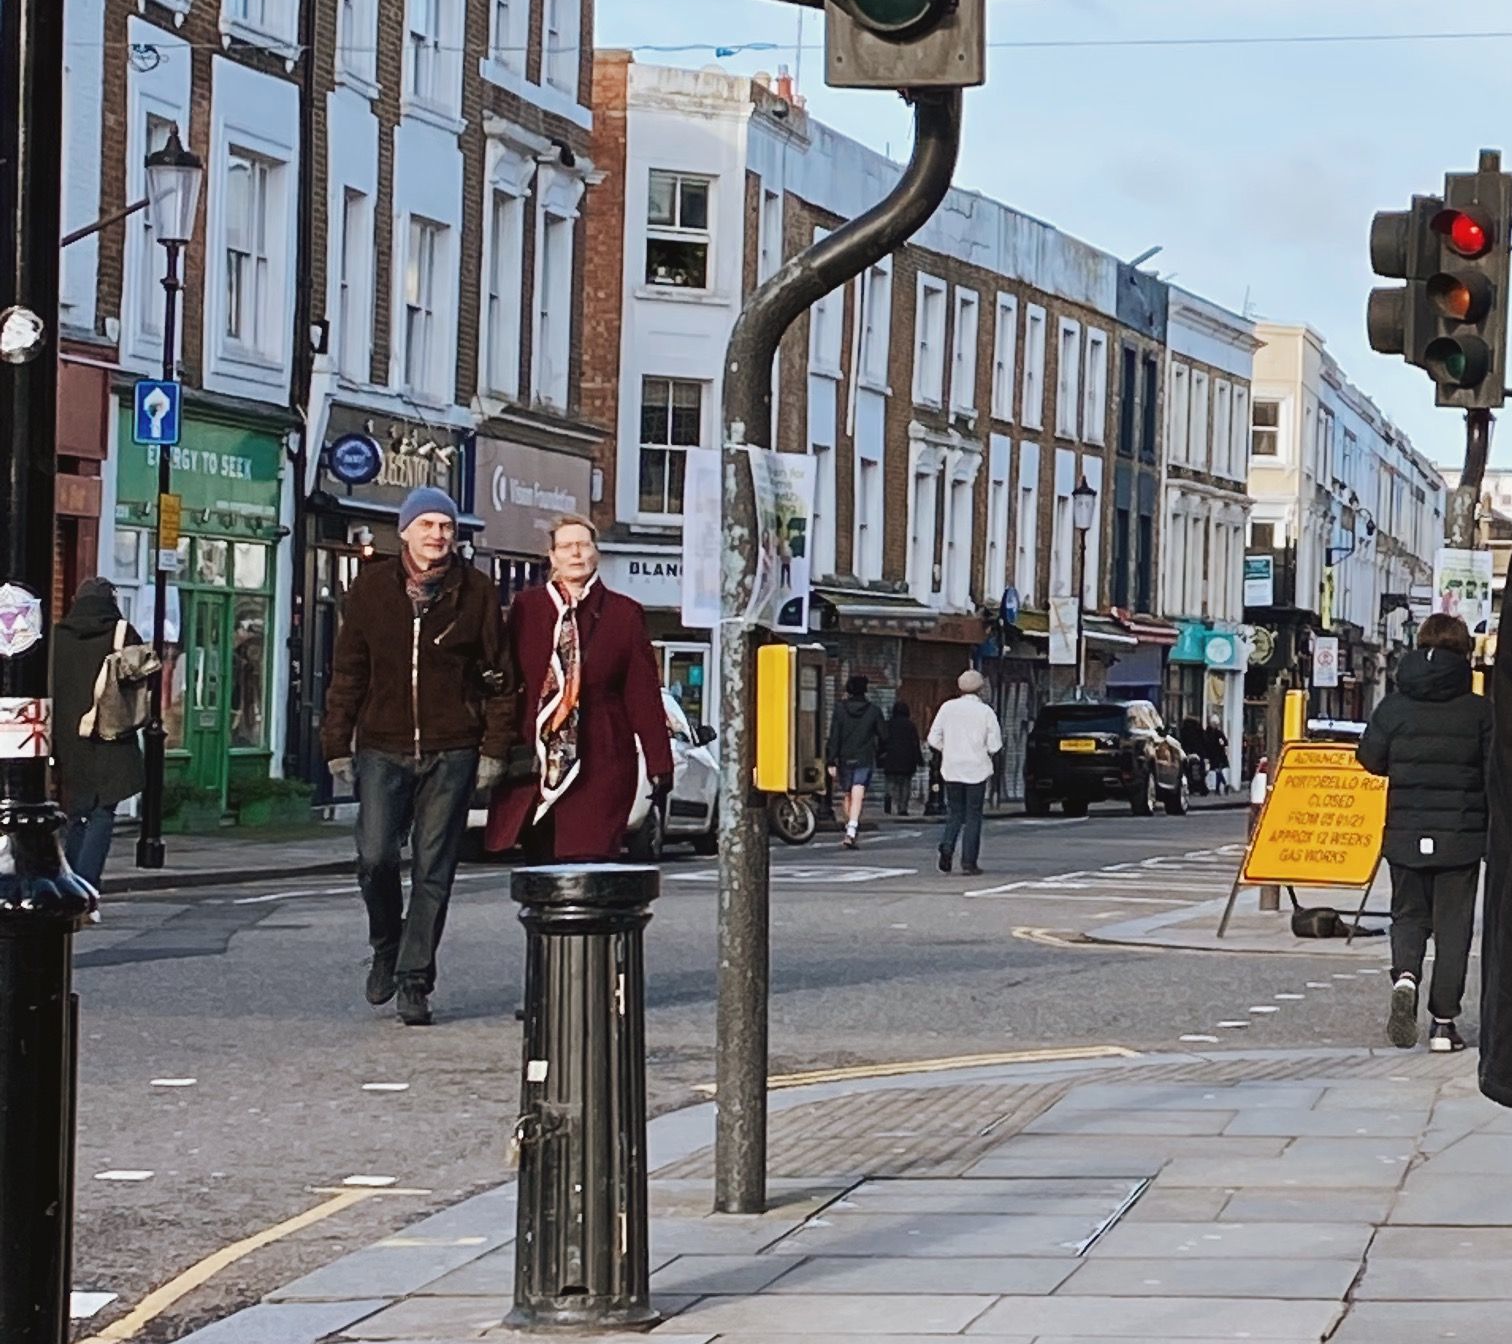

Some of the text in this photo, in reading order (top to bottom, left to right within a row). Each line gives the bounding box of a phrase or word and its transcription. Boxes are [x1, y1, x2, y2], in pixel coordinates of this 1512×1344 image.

[200, 451, 218, 475] TO
[1285, 775, 1358, 789] PORTOBELLO
[1308, 794, 1355, 809] CLOSED
[1288, 810, 1318, 825] FROM
[1330, 832, 1373, 848] WEEKS
[1280, 849, 1347, 863] GAS WORKS
